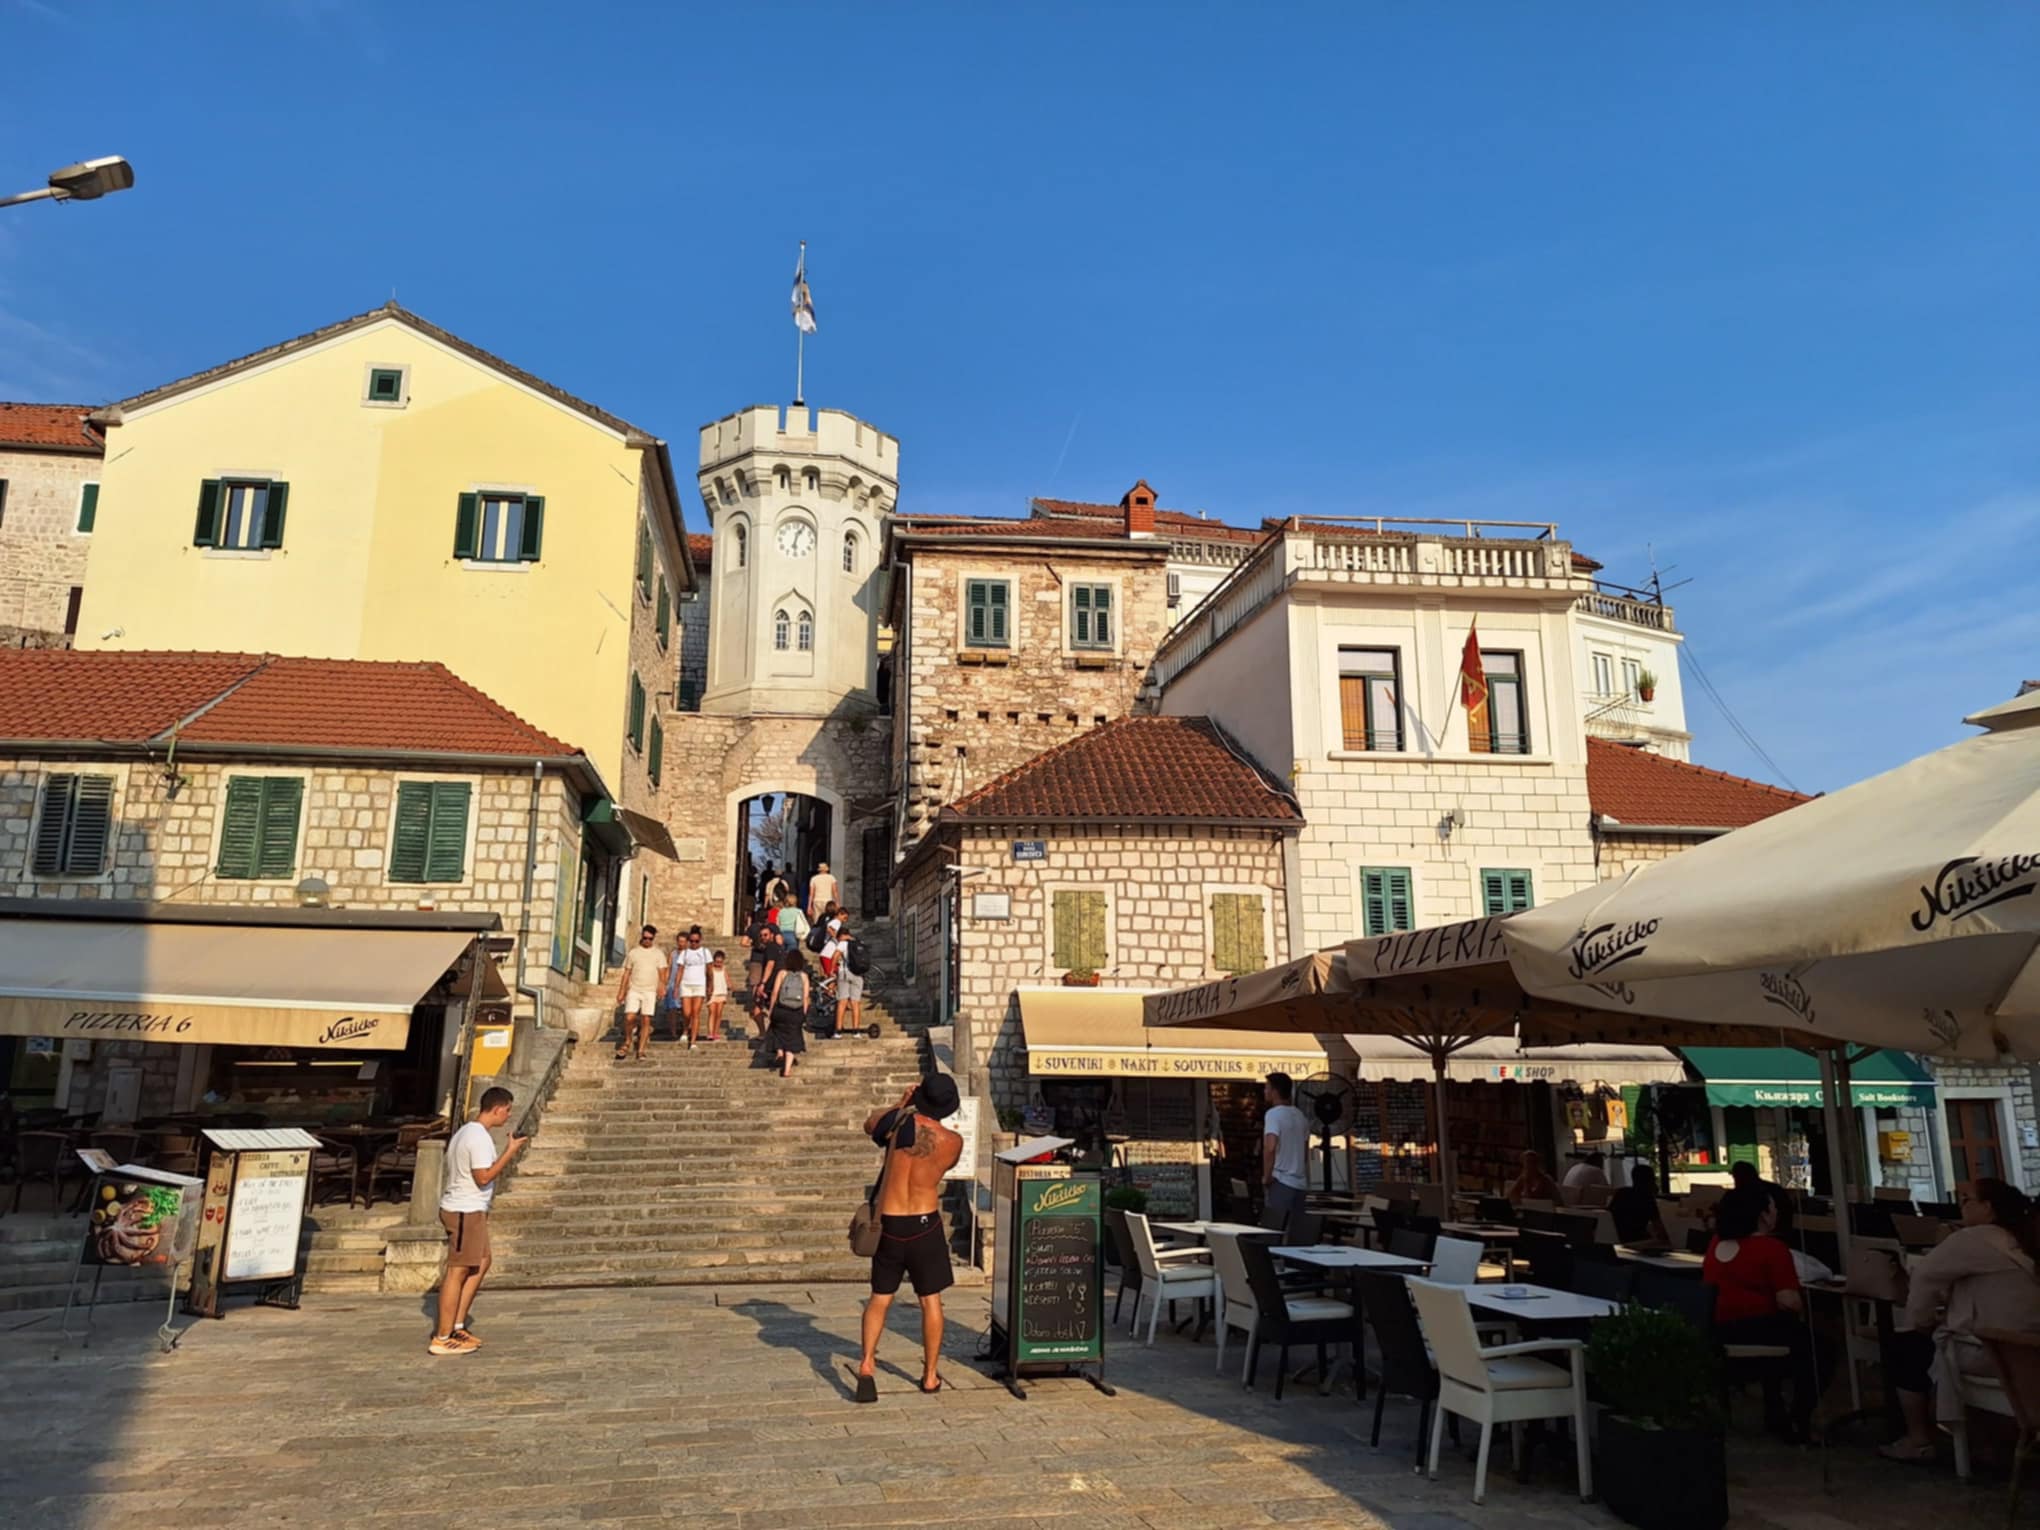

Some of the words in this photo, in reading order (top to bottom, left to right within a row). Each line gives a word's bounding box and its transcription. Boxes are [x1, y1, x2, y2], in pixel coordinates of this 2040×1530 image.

[1568, 917, 1662, 979] Nikšićko
[1157, 983, 1220, 1022] PIZZERIA
[63, 1012, 169, 1033] PIZZERIA
[176, 1014, 193, 1033] 6
[1045, 1057, 1103, 1071] SUVENIRI
[1120, 1058, 1159, 1072] NAKIT
[1173, 1059, 1243, 1073] SOUVENIRS
[1256, 1061, 1311, 1075] JEWELRY
[1525, 1066, 1555, 1078] SHOP
